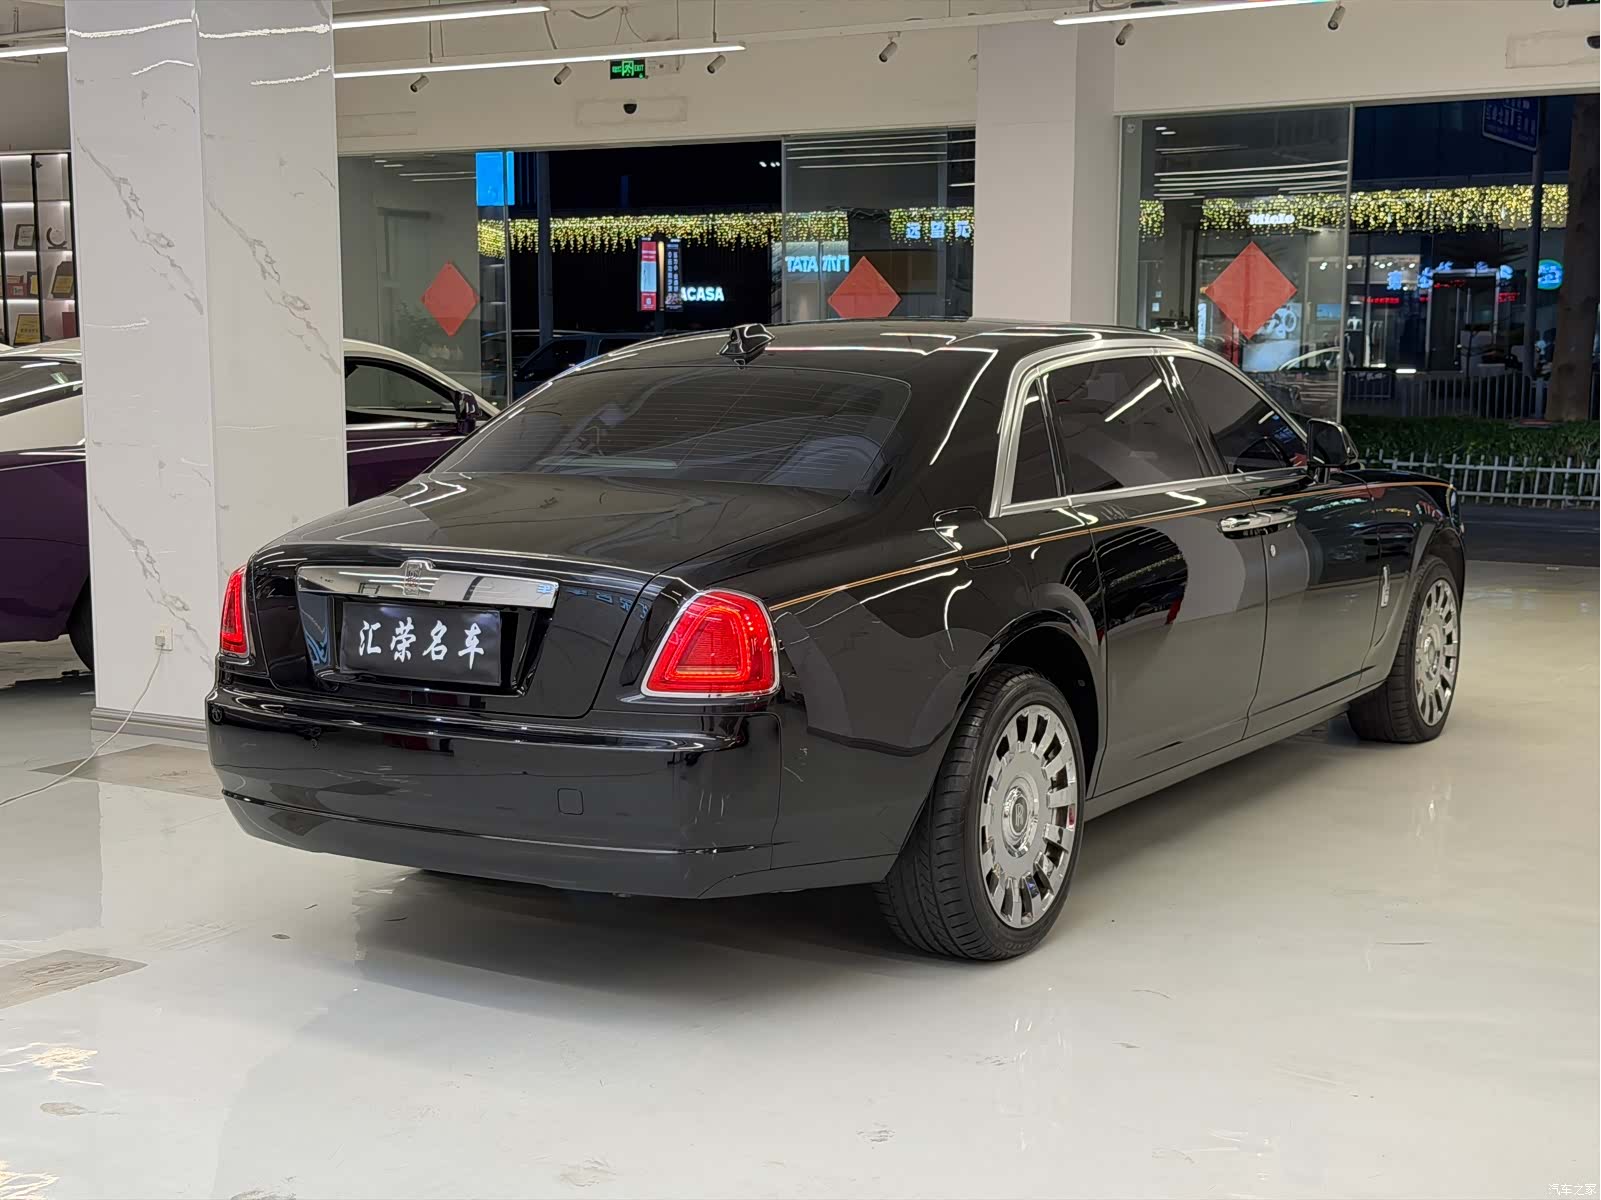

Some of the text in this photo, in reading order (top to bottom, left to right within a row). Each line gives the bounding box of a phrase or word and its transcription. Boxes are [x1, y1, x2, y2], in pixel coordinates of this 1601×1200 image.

[785, 254, 850, 272] TATA 木门
[358, 616, 485, 670] 汇荣名车
